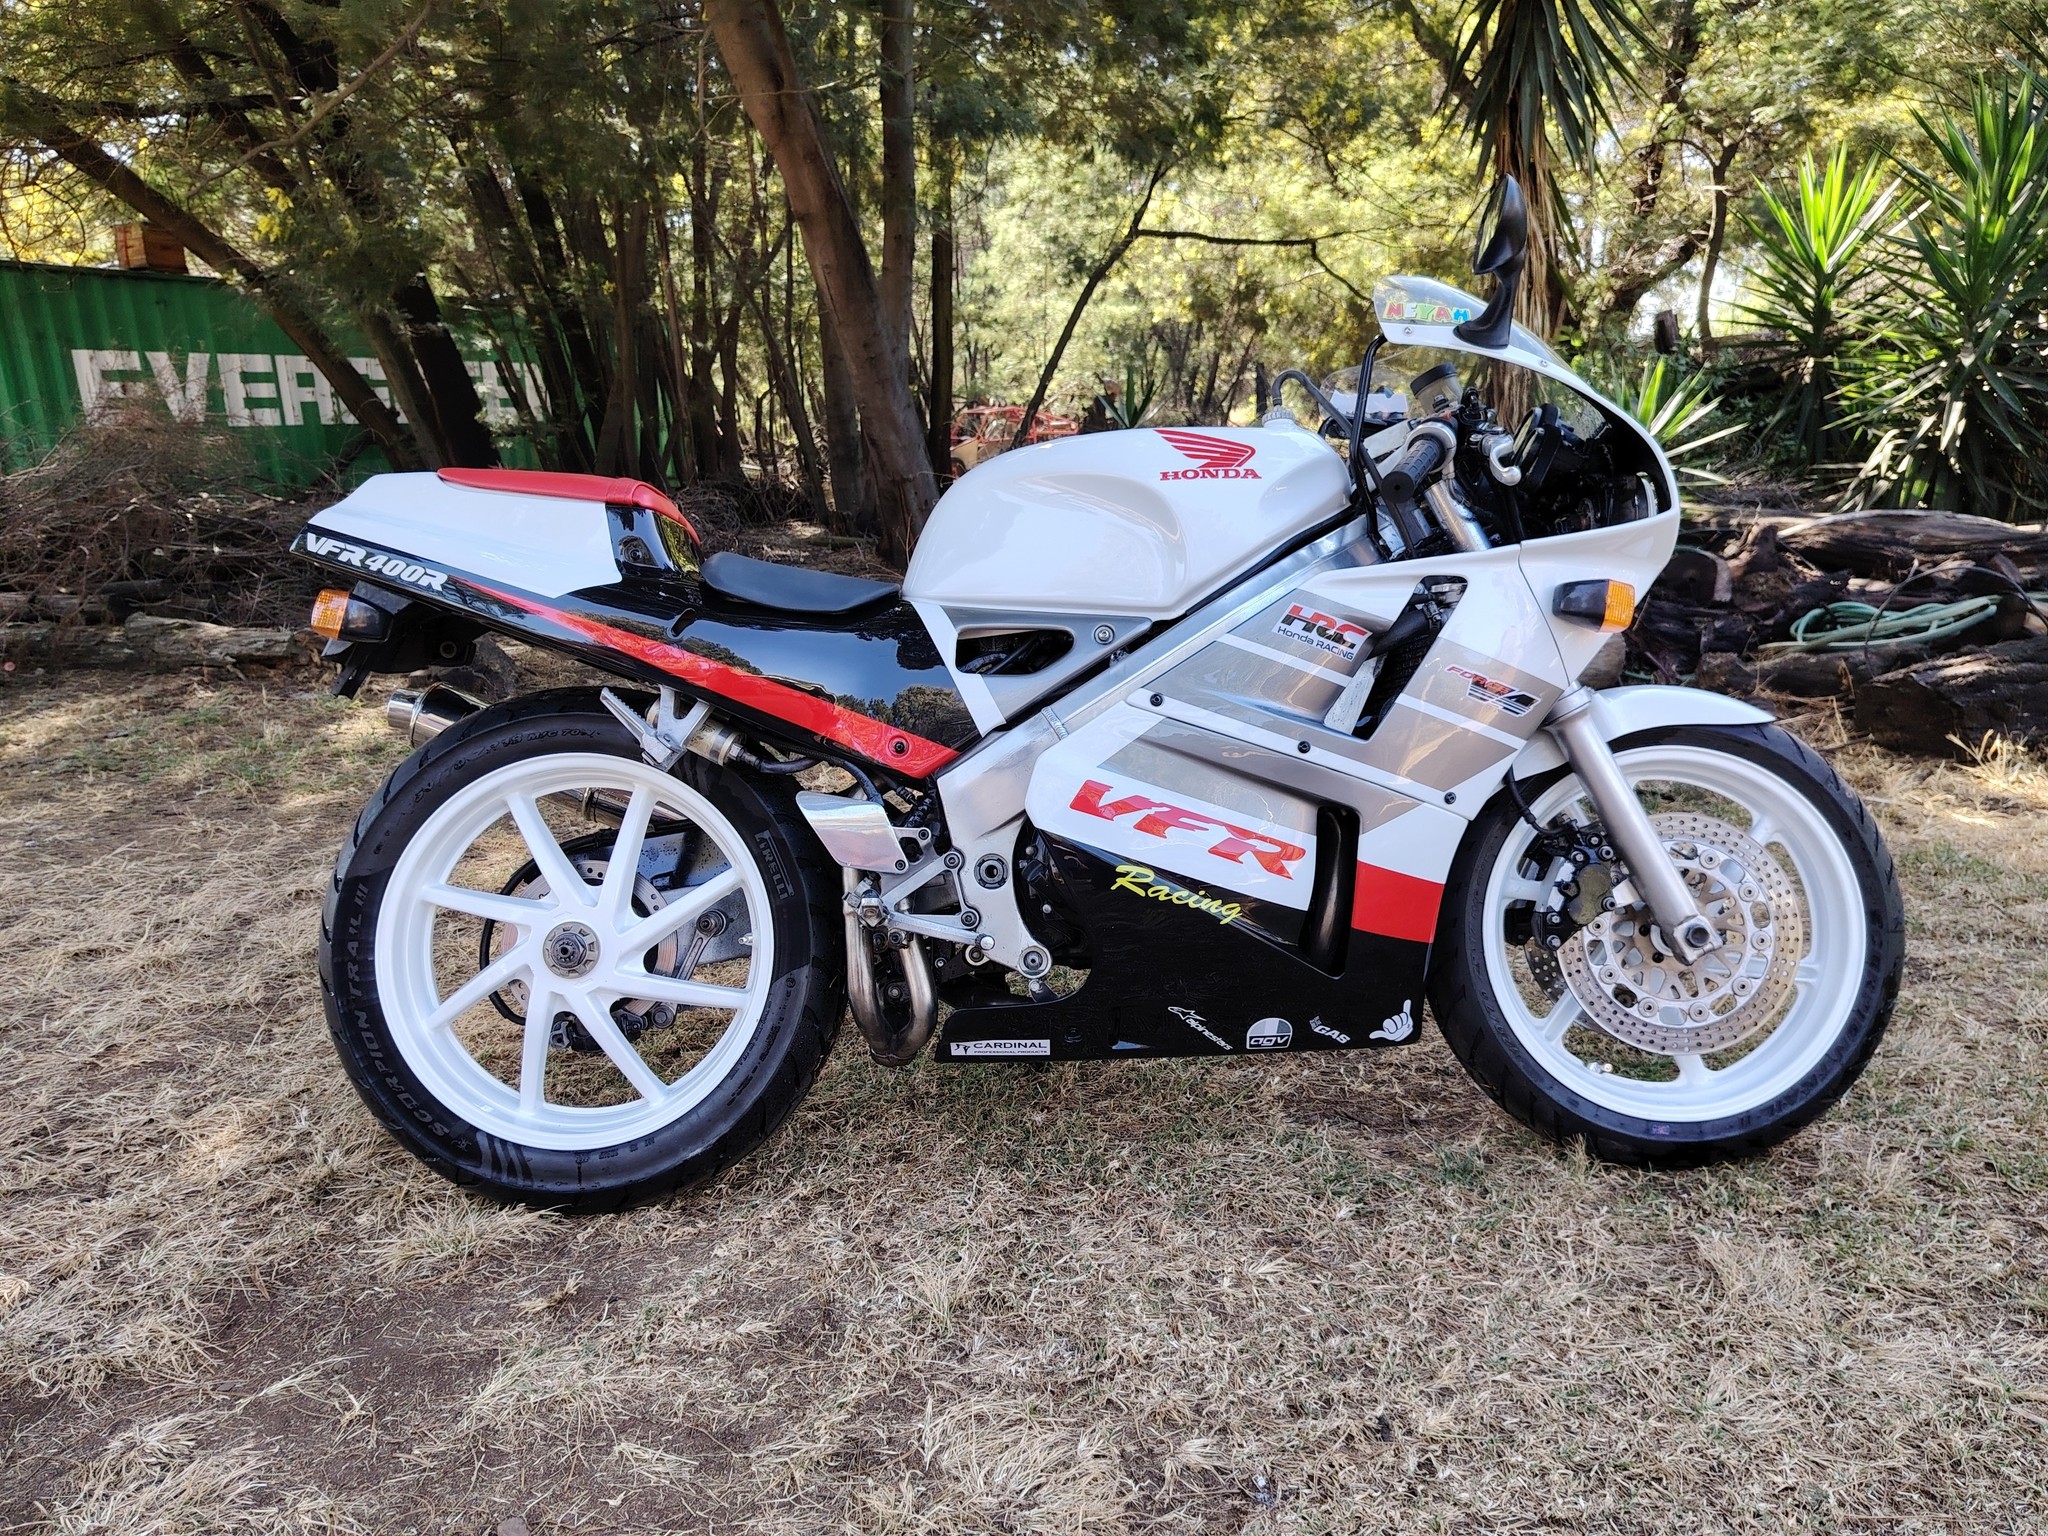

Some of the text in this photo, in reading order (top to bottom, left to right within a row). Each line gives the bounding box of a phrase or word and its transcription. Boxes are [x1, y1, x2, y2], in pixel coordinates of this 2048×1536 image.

[1160, 468, 1262, 481] HONDA
[1277, 626, 1355, 661] Honda RACING
[1281, 604, 1368, 650] HRC
[1069, 779, 1306, 880] VFR
[754, 829, 795, 900] PIRELLI
[1110, 864, 1243, 925] Racing
[346, 911, 363, 1000] TRAIL
[1185, 1018, 1233, 1050] alpinestars
[1250, 1035, 1289, 1047] agv
[1313, 1024, 1351, 1045] GAS
[353, 1008, 449, 1138] SCORPION
